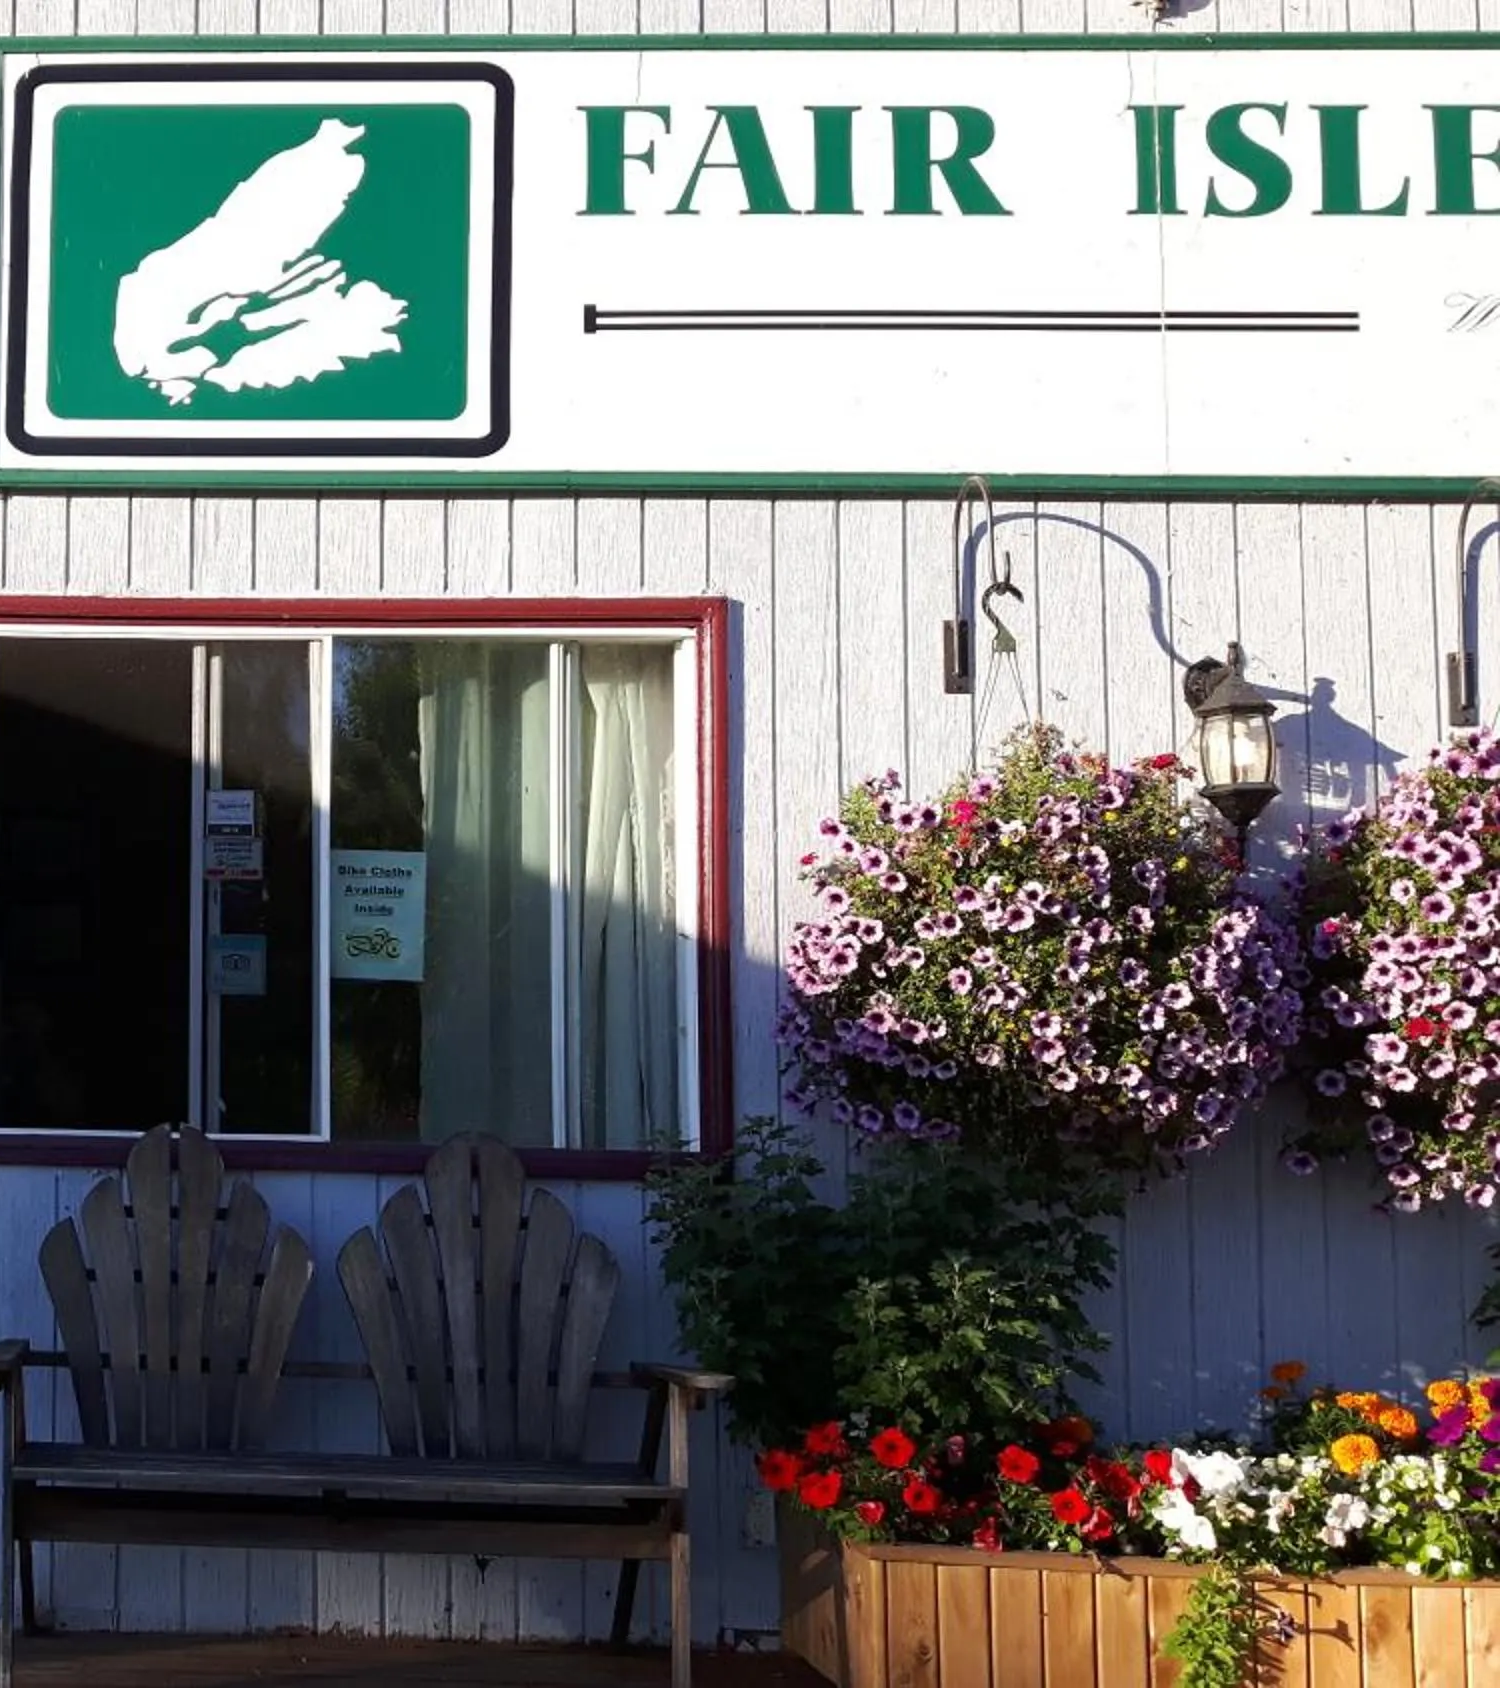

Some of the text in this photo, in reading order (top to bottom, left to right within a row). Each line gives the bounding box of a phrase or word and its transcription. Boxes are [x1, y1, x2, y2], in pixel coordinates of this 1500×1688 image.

[576, 101, 1500, 218] FAIR ISLE
[338, 865, 366, 876] Bike
[345, 884, 405, 896] Available
[355, 903, 394, 916] Inside
